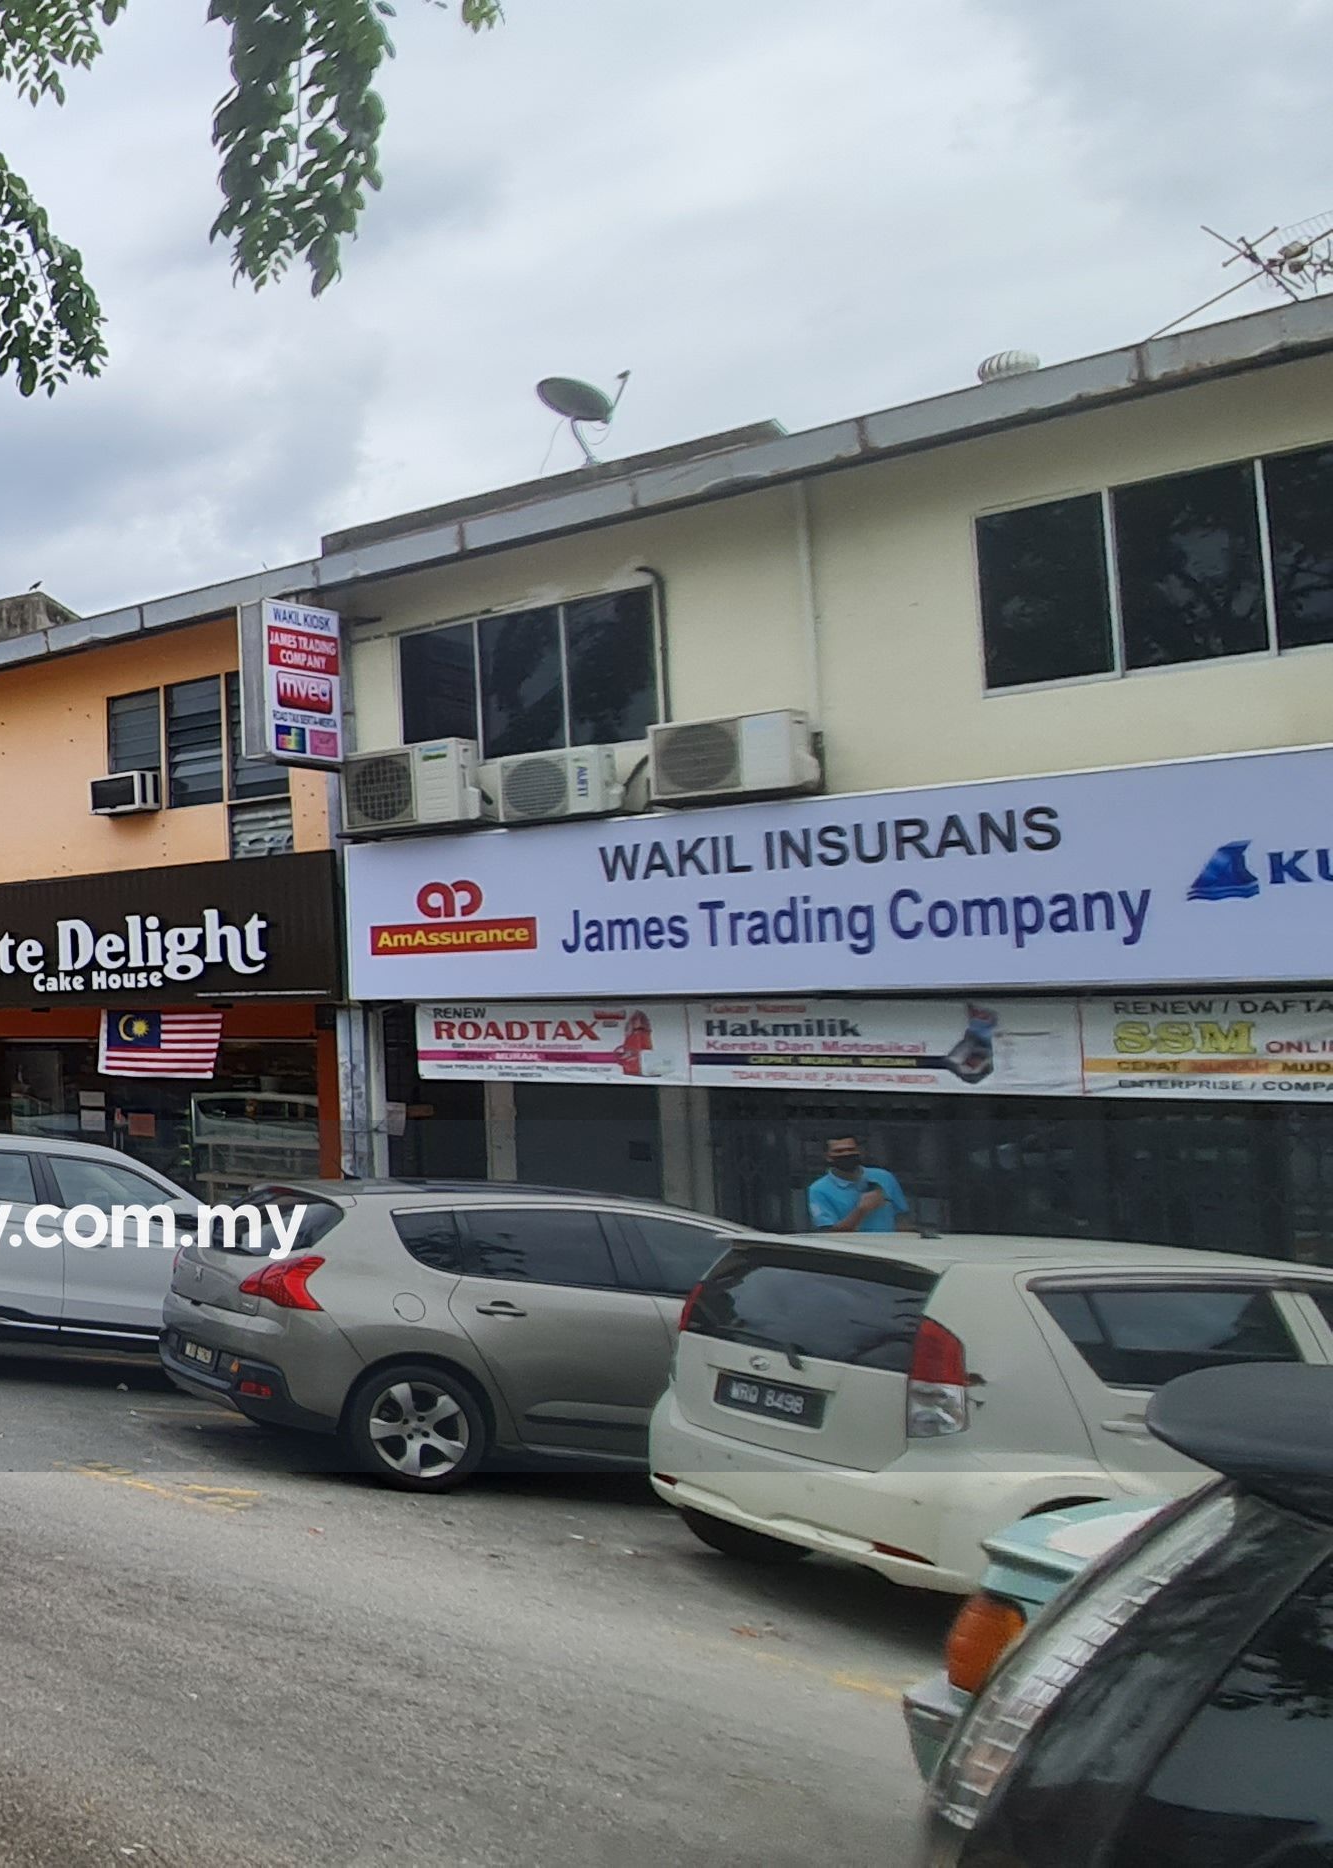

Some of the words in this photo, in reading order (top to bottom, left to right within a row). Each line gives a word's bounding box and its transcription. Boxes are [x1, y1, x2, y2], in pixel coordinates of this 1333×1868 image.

[273, 608, 302, 626] WAKIL
[303, 614, 331, 632] KIOSK
[269, 631, 297, 647] JAMES
[298, 635, 336, 656] TRADING
[280, 650, 327, 670] COMPANY
[598, 834, 753, 882] WAKIL
[764, 806, 1062, 871] INSURANS
[562, 909, 690, 954] James
[698, 895, 876, 955] Trading
[889, 888, 1151, 949] Company
[57, 908, 268, 981] Delight
[377, 927, 530, 948] AmAssurance
[33, 973, 85, 992] Cake
[92, 970, 164, 990] House
[434, 1007, 486, 1019] RENEW
[1113, 1001, 1213, 1014] RENEW
[434, 1020, 600, 1041] ROADTAX
[705, 1019, 861, 1037] Hakmilik
[1113, 1020, 1257, 1054] SSM
[1117, 1061, 1180, 1071] CEPAT
[1281, 1061, 1333, 1072] MUD
[1118, 1079, 1243, 1090] ENTERPRISE
